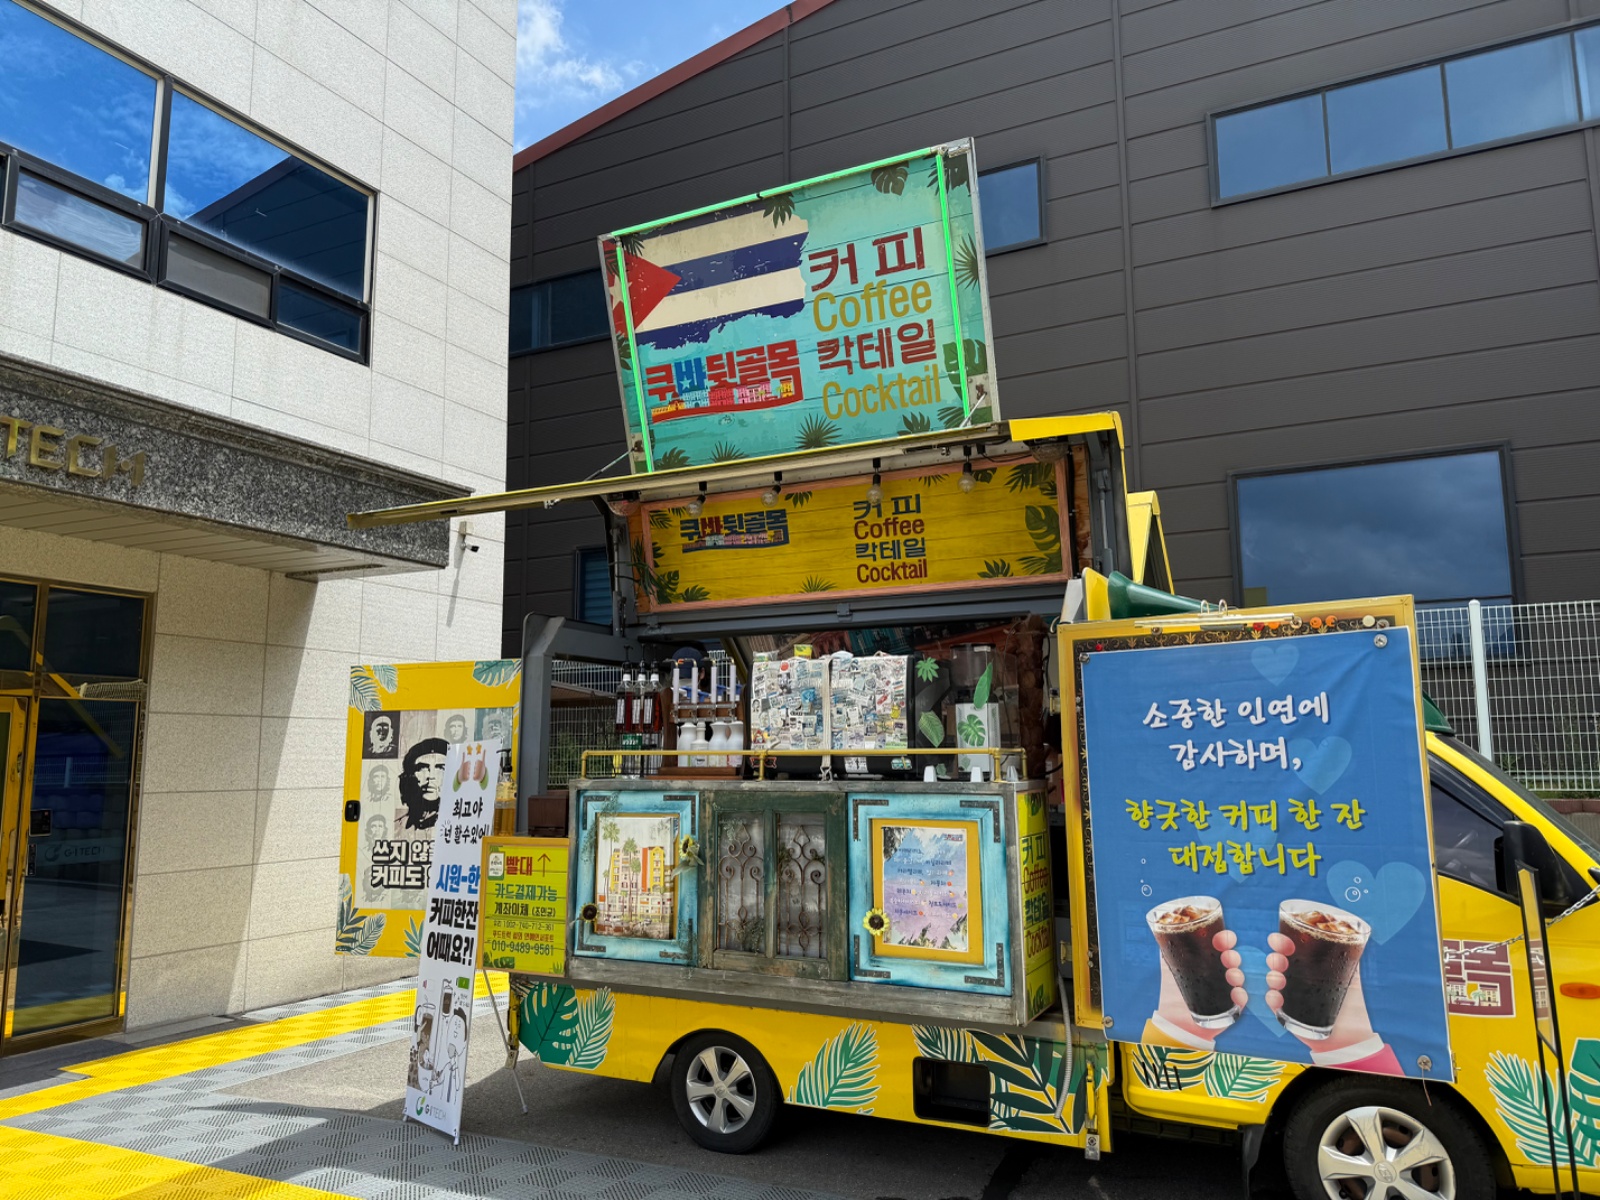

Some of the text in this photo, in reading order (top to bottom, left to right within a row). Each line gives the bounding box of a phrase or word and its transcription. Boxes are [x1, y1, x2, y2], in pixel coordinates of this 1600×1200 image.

[813, 279, 932, 332] Coffee
[817, 319, 937, 374] 칵테일
[645, 340, 804, 418] 쿠바뒷골목
[822, 365, 941, 419] Cocktail
[0, 416, 146, 487] TECH
[680, 508, 790, 551] 쿠바뒷골목
[854, 518, 925, 540] Coffee
[856, 537, 926, 562] 칵테일
[857, 559, 928, 583] Cocktail
[1142, 691, 1331, 730] 소중한 인연에
[1168, 737, 1304, 772] 감사하며,
[452, 796, 484, 820] 최고야
[1125, 798, 1367, 832] 향긋한 커피 한 잔
[444, 824, 453, 844] 넌
[372, 840, 409, 863] 쓰지
[505, 855, 533, 876] 빨대
[1168, 840, 1323, 876] 대접합니다
[370, 864, 425, 890] 커피도
[494, 883, 558, 902] 카드결제가능
[1023, 863, 1049, 895] Coffee
[429, 898, 479, 930] 커피한잔
[494, 902, 529, 916] 계좌이체
[1025, 892, 1050, 926] 칵테일
[426, 931, 474, 966] 어때요?!
[491, 940, 554, 956] 010-9489-9561
